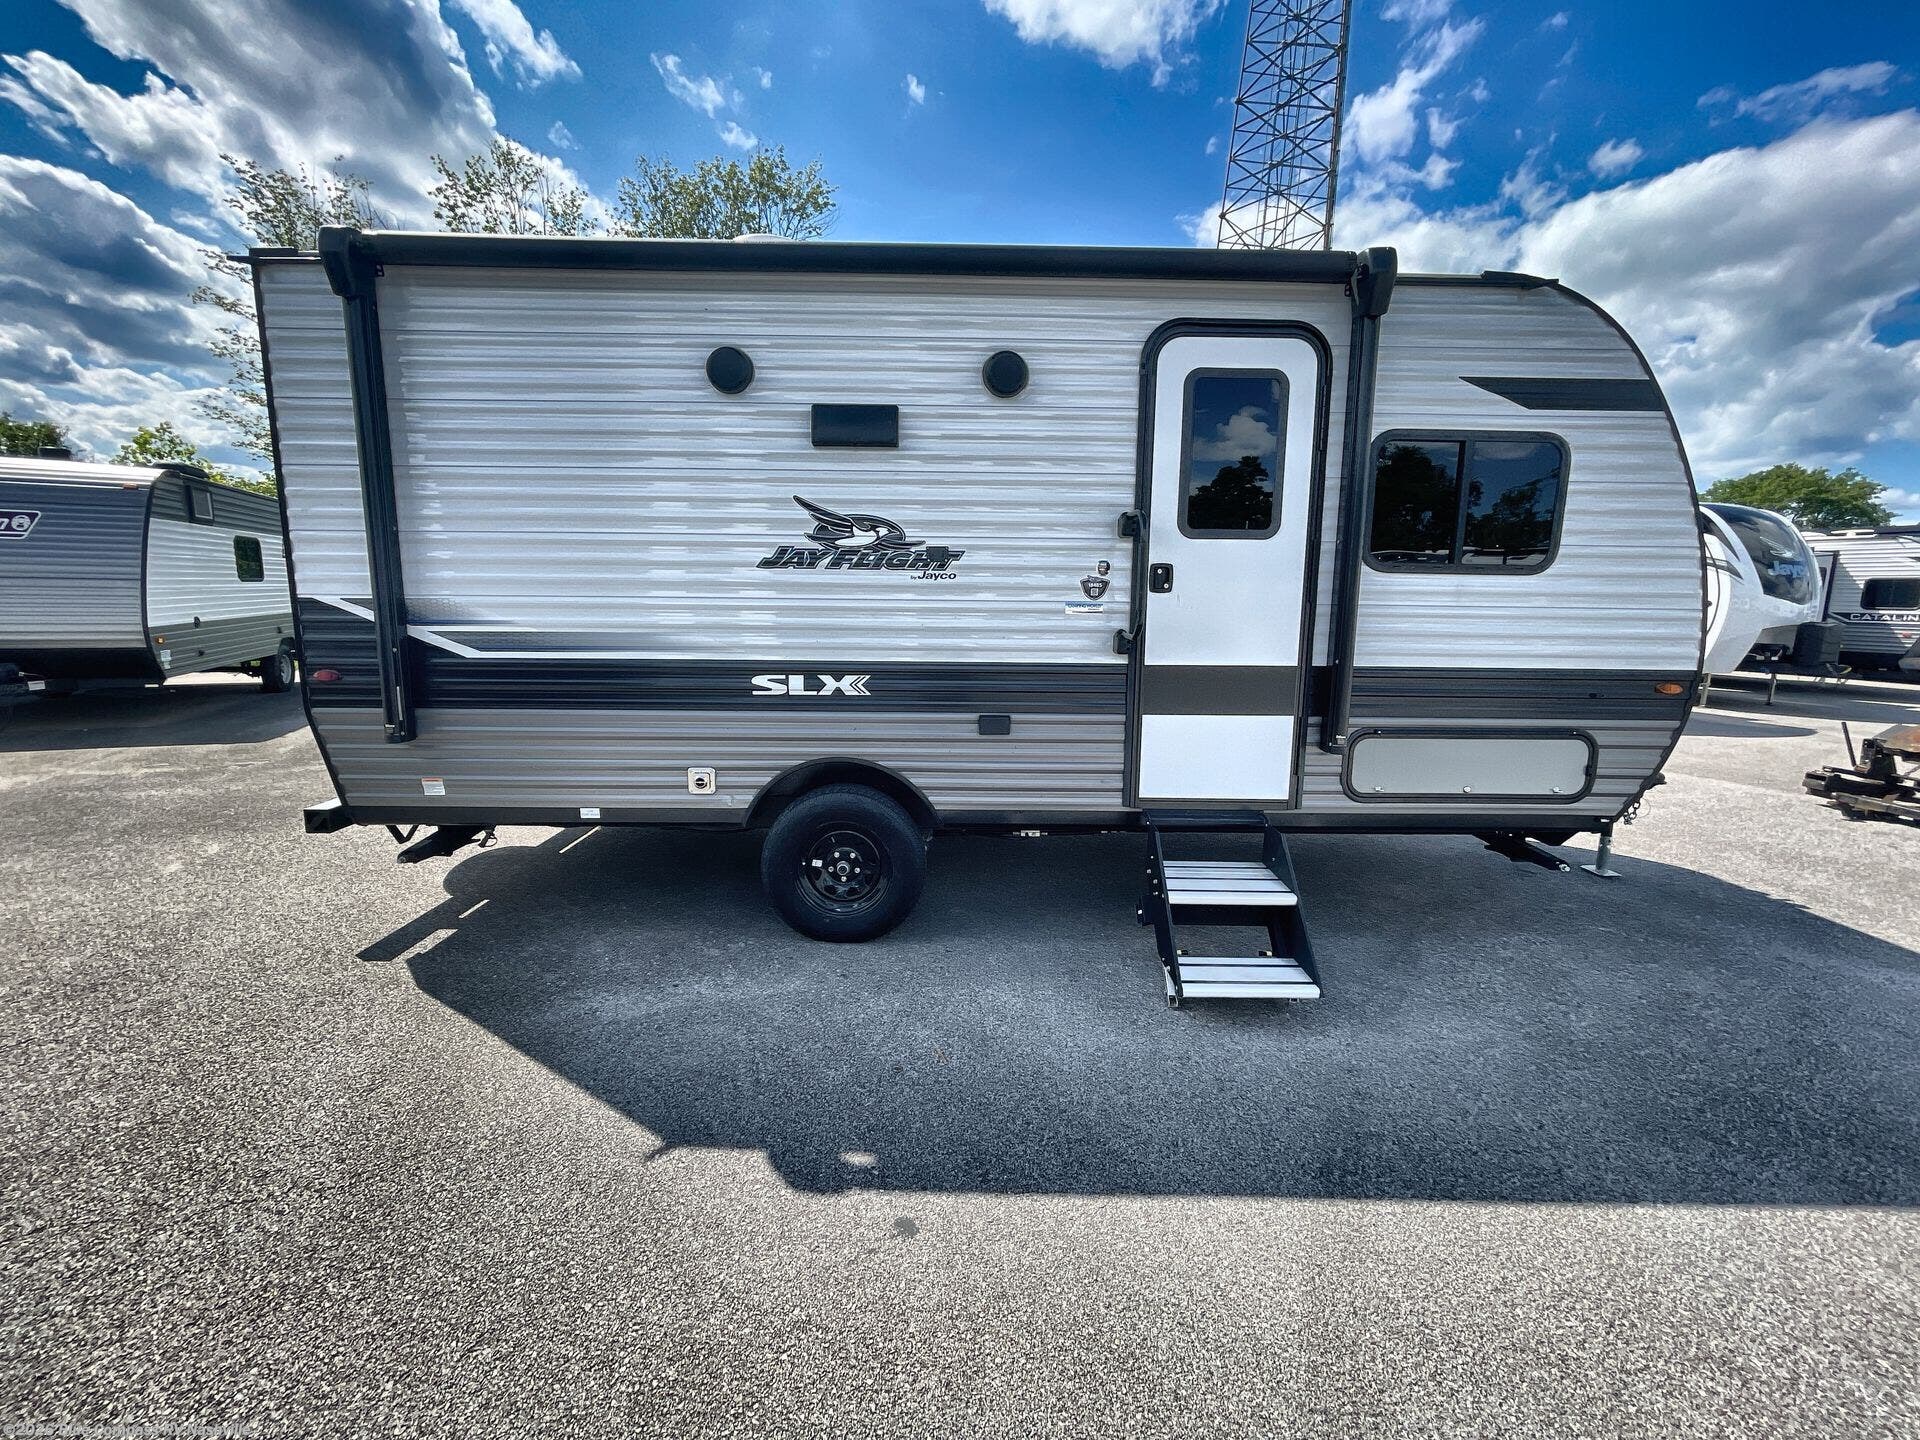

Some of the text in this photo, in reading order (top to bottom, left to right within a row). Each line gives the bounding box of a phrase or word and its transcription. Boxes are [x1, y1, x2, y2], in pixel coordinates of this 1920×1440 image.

[756, 546, 835, 569] JAY
[917, 571, 957, 581] Jayco
[751, 674, 872, 696] SLX
